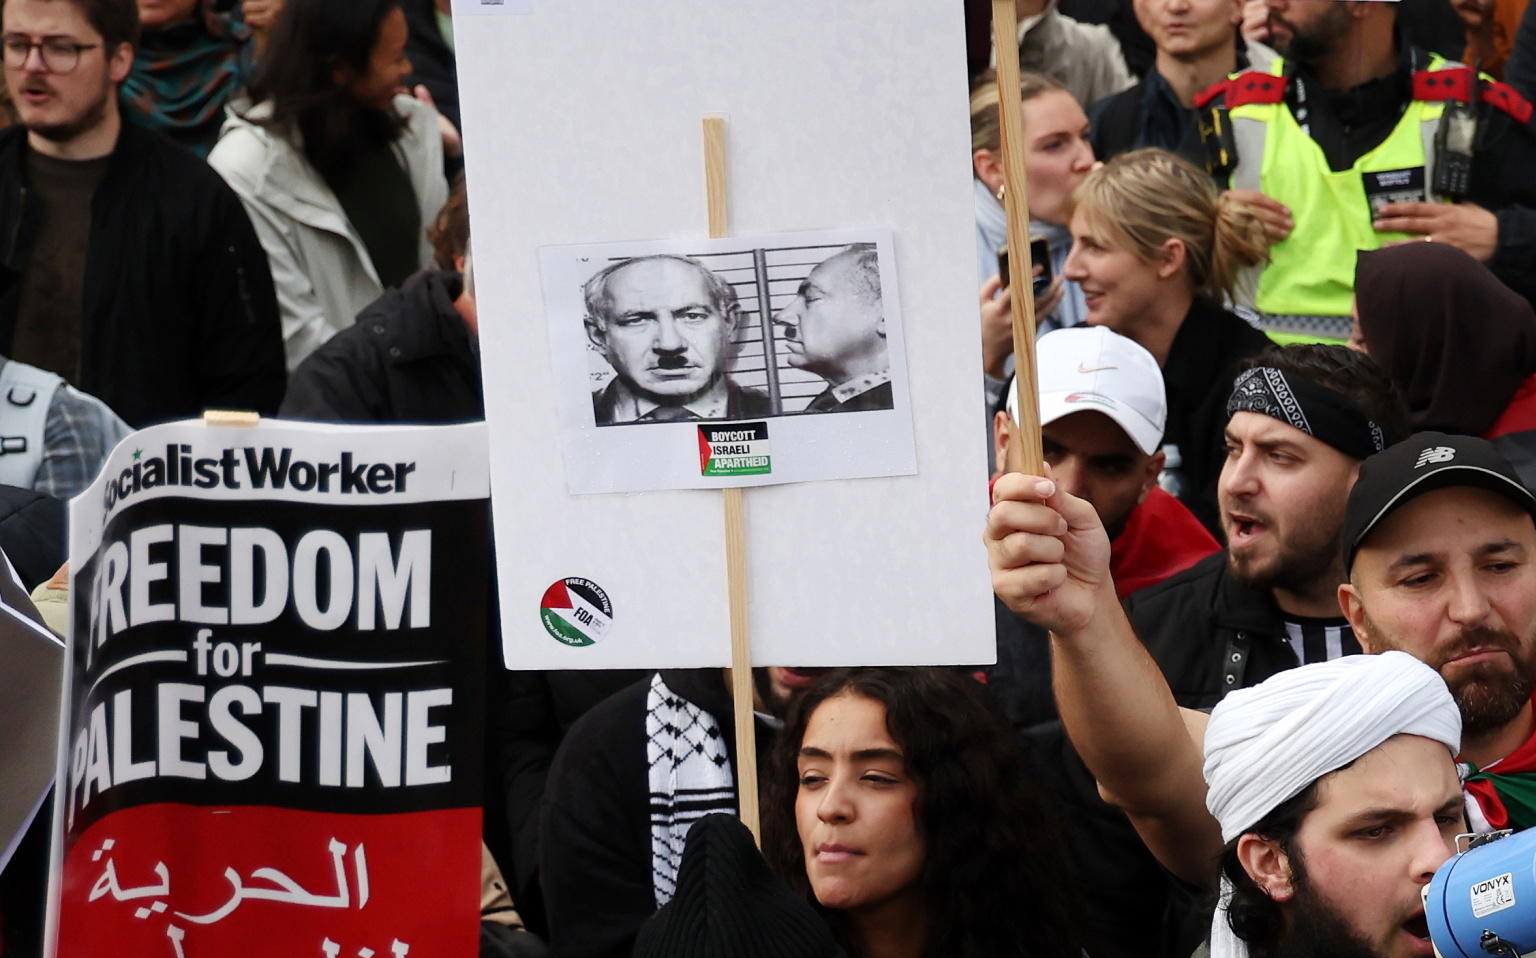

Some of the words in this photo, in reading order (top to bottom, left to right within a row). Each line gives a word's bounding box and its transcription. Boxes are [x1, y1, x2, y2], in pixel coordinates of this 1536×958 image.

[711, 430, 756, 442] BOYCOTT
[713, 444, 751, 455] ISRAELI
[243, 447, 416, 494] Worker
[714, 456, 769, 468] APARTHEID
[565, 578, 585, 586] FREE
[585, 581, 611, 613] PALESTINE
[573, 606, 594, 627] FOA
[193, 629, 262, 677] for
[68, 683, 453, 832] PALESTINE
[89, 837, 369, 924] الحرية
[1472, 874, 1509, 896] VONYX
